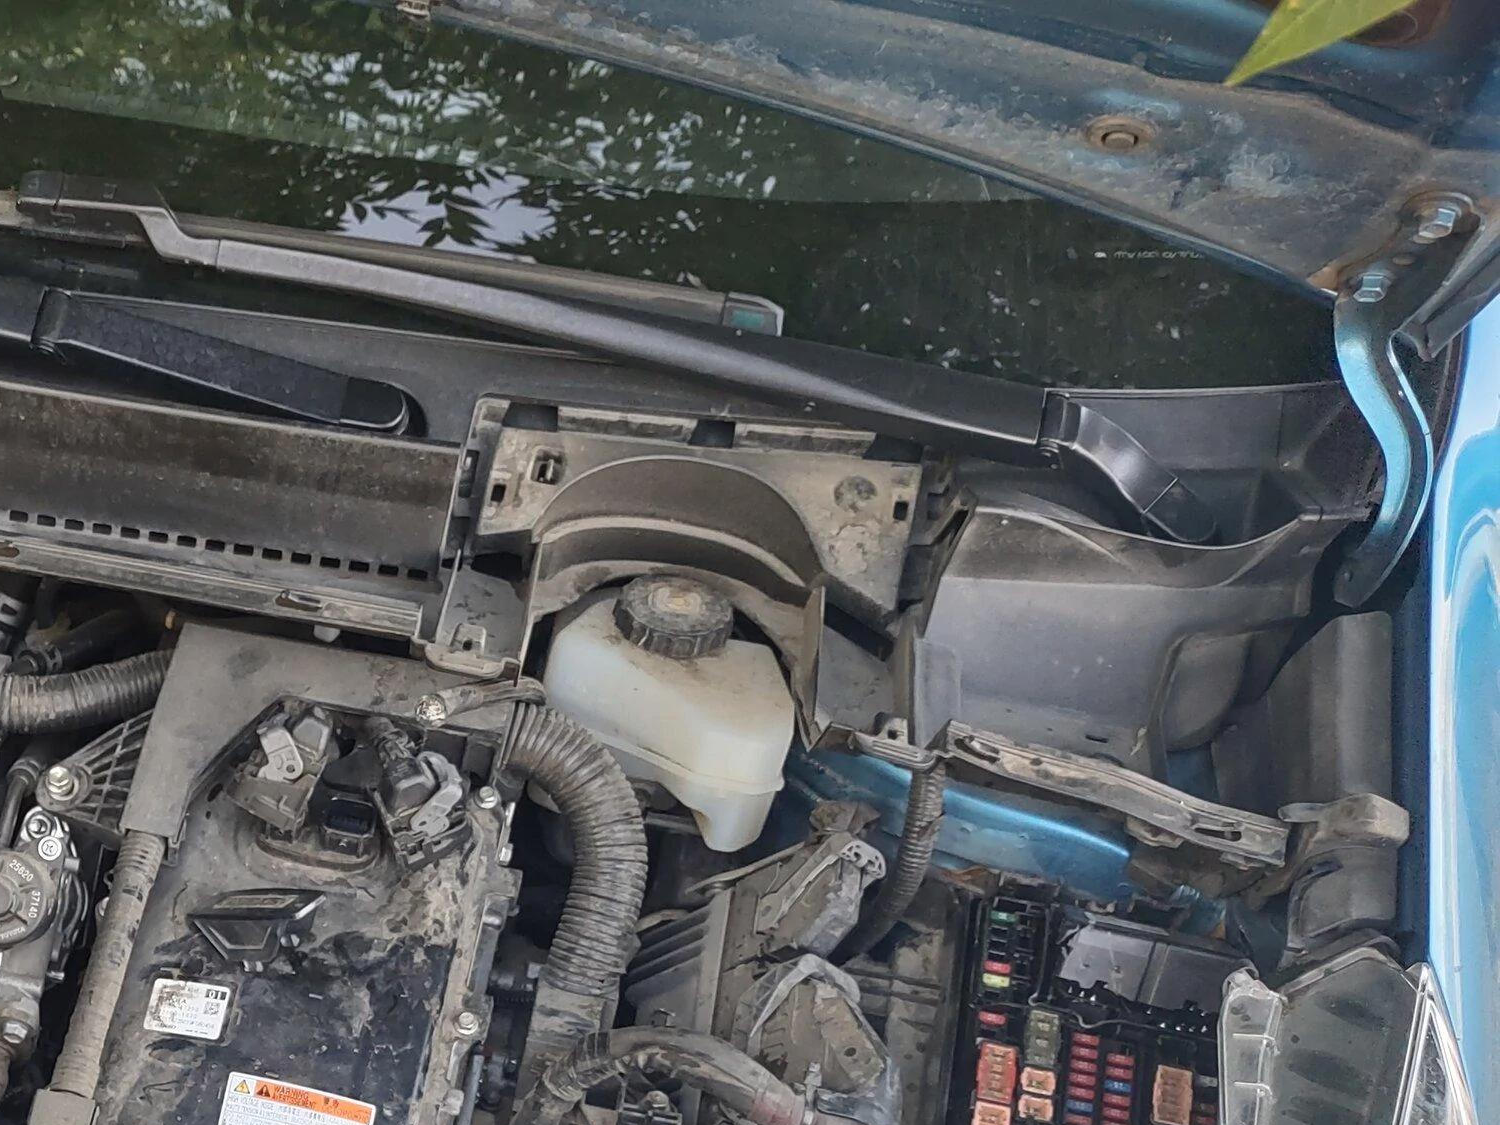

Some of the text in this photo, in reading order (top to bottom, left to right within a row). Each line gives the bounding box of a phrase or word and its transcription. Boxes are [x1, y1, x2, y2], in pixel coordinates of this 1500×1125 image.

[9, 859, 34, 882] 25620
[28, 890, 41, 918] 37140
[274, 1085, 309, 1100] WARNING
